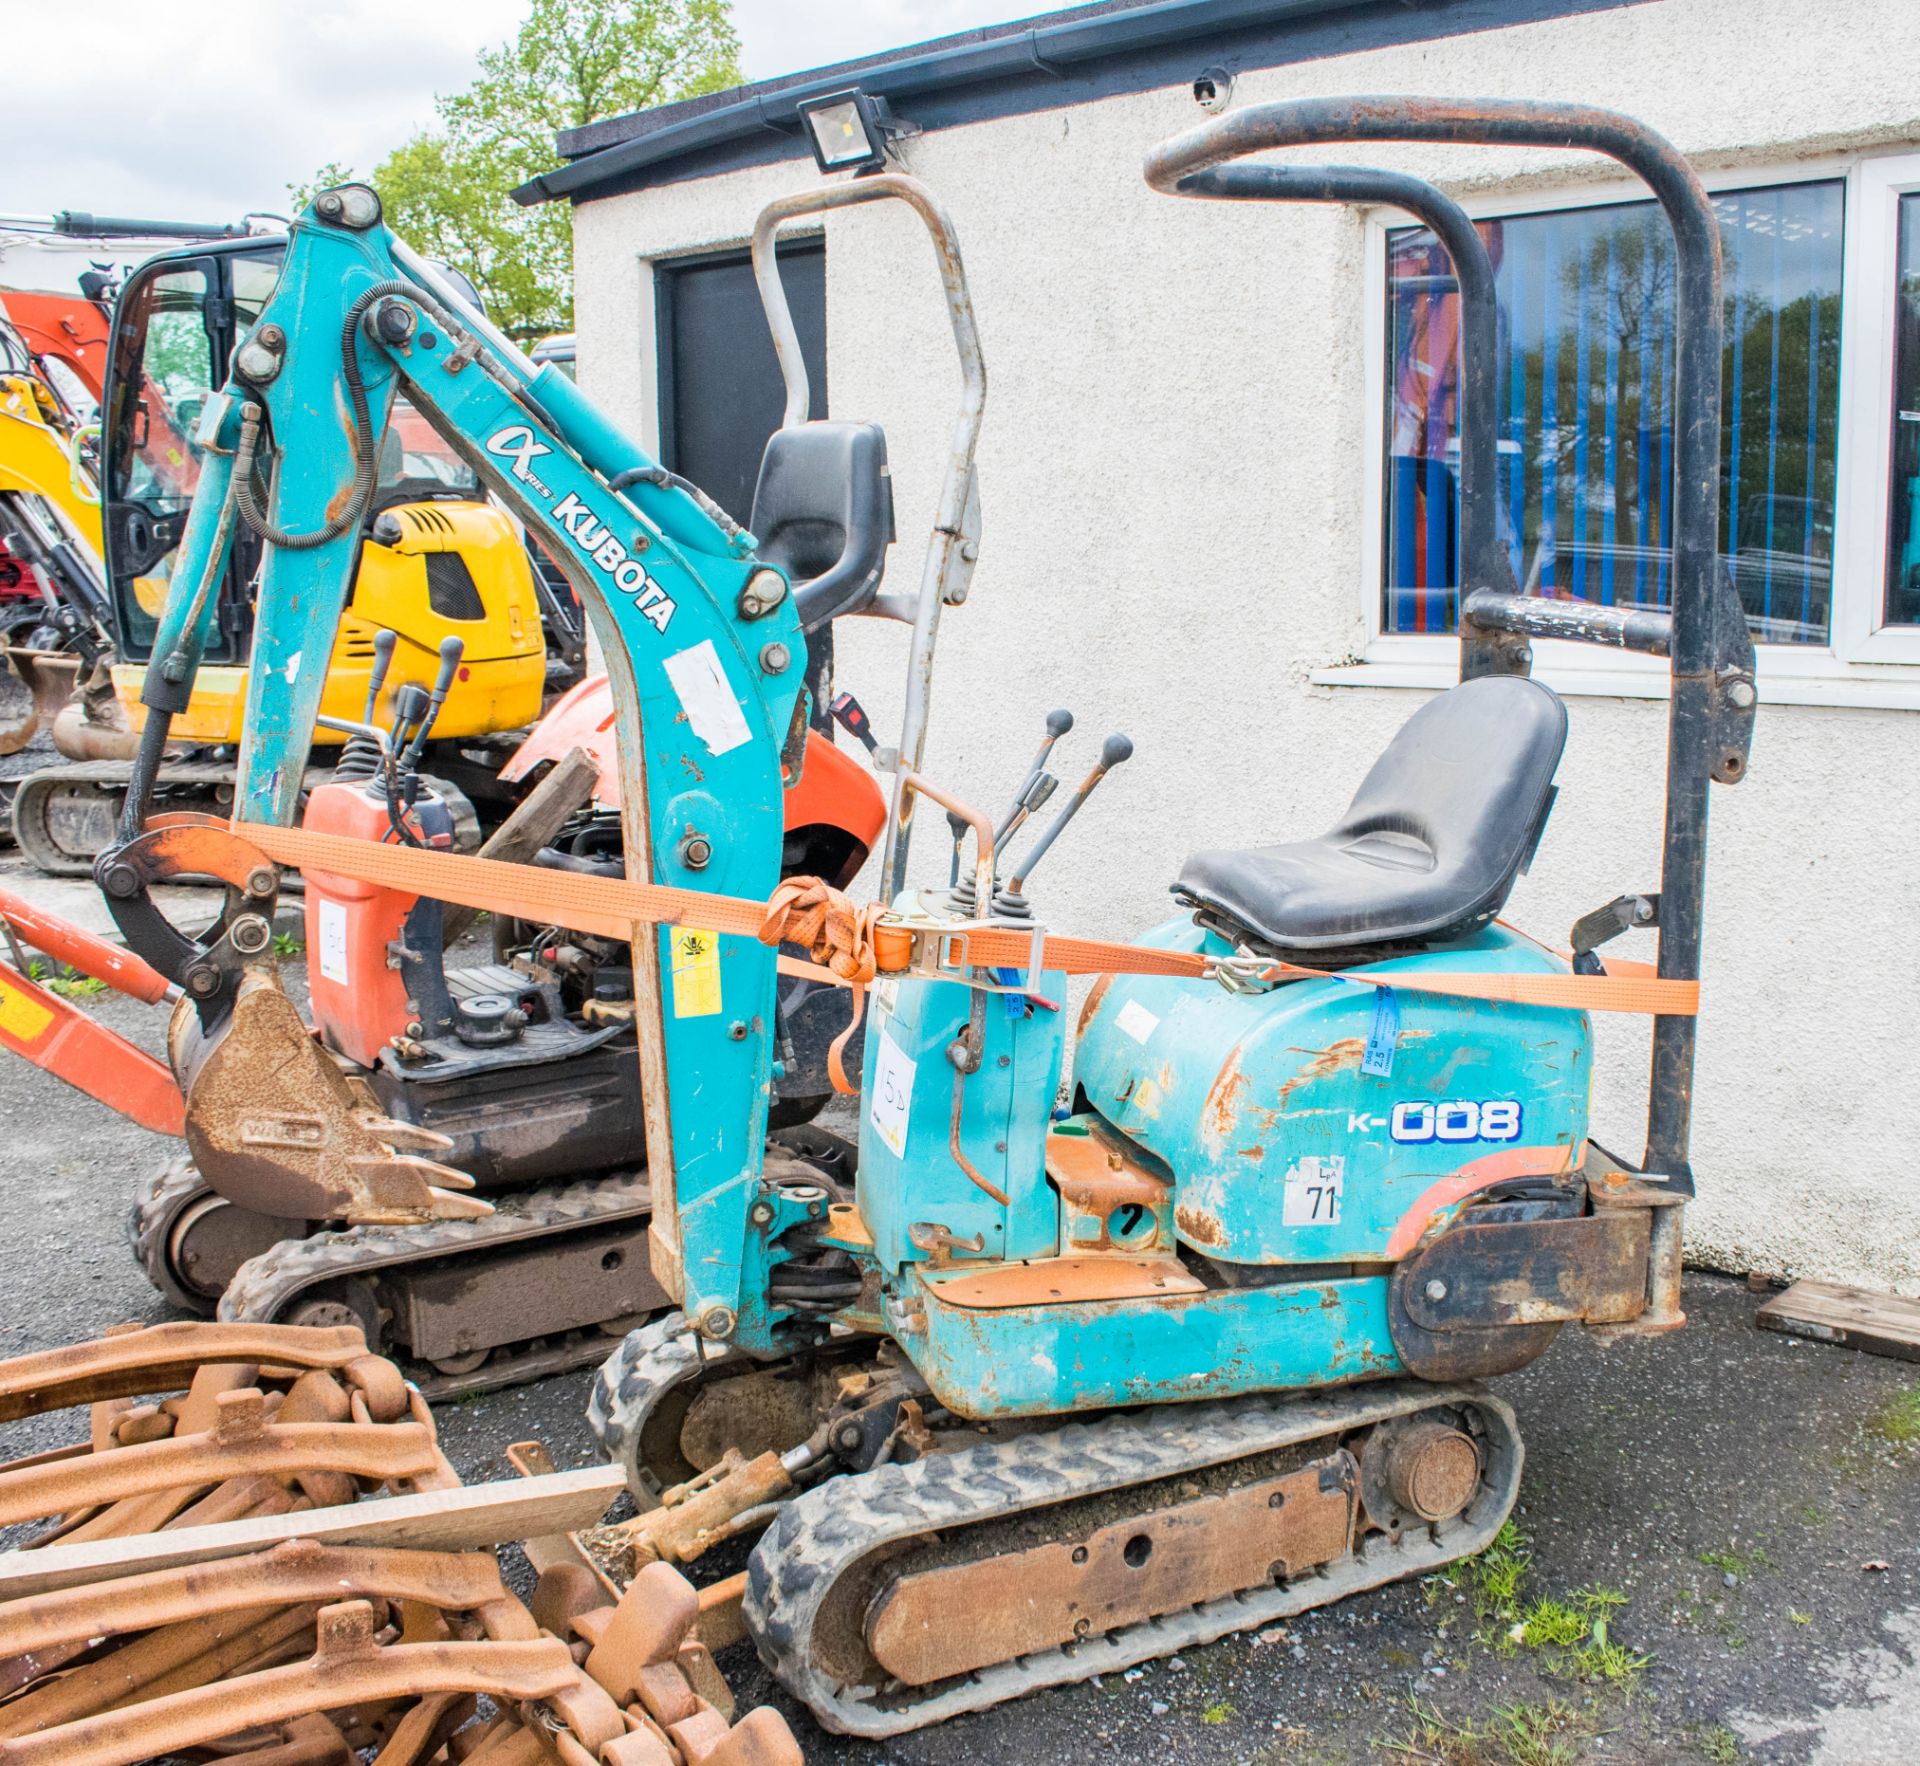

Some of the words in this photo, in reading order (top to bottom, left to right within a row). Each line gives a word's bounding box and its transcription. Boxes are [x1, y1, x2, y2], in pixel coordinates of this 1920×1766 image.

[550, 491, 678, 636] KUBOTA
[1373, 1051, 1385, 1069] 2.5
[1306, 1186, 1335, 1219] 71
